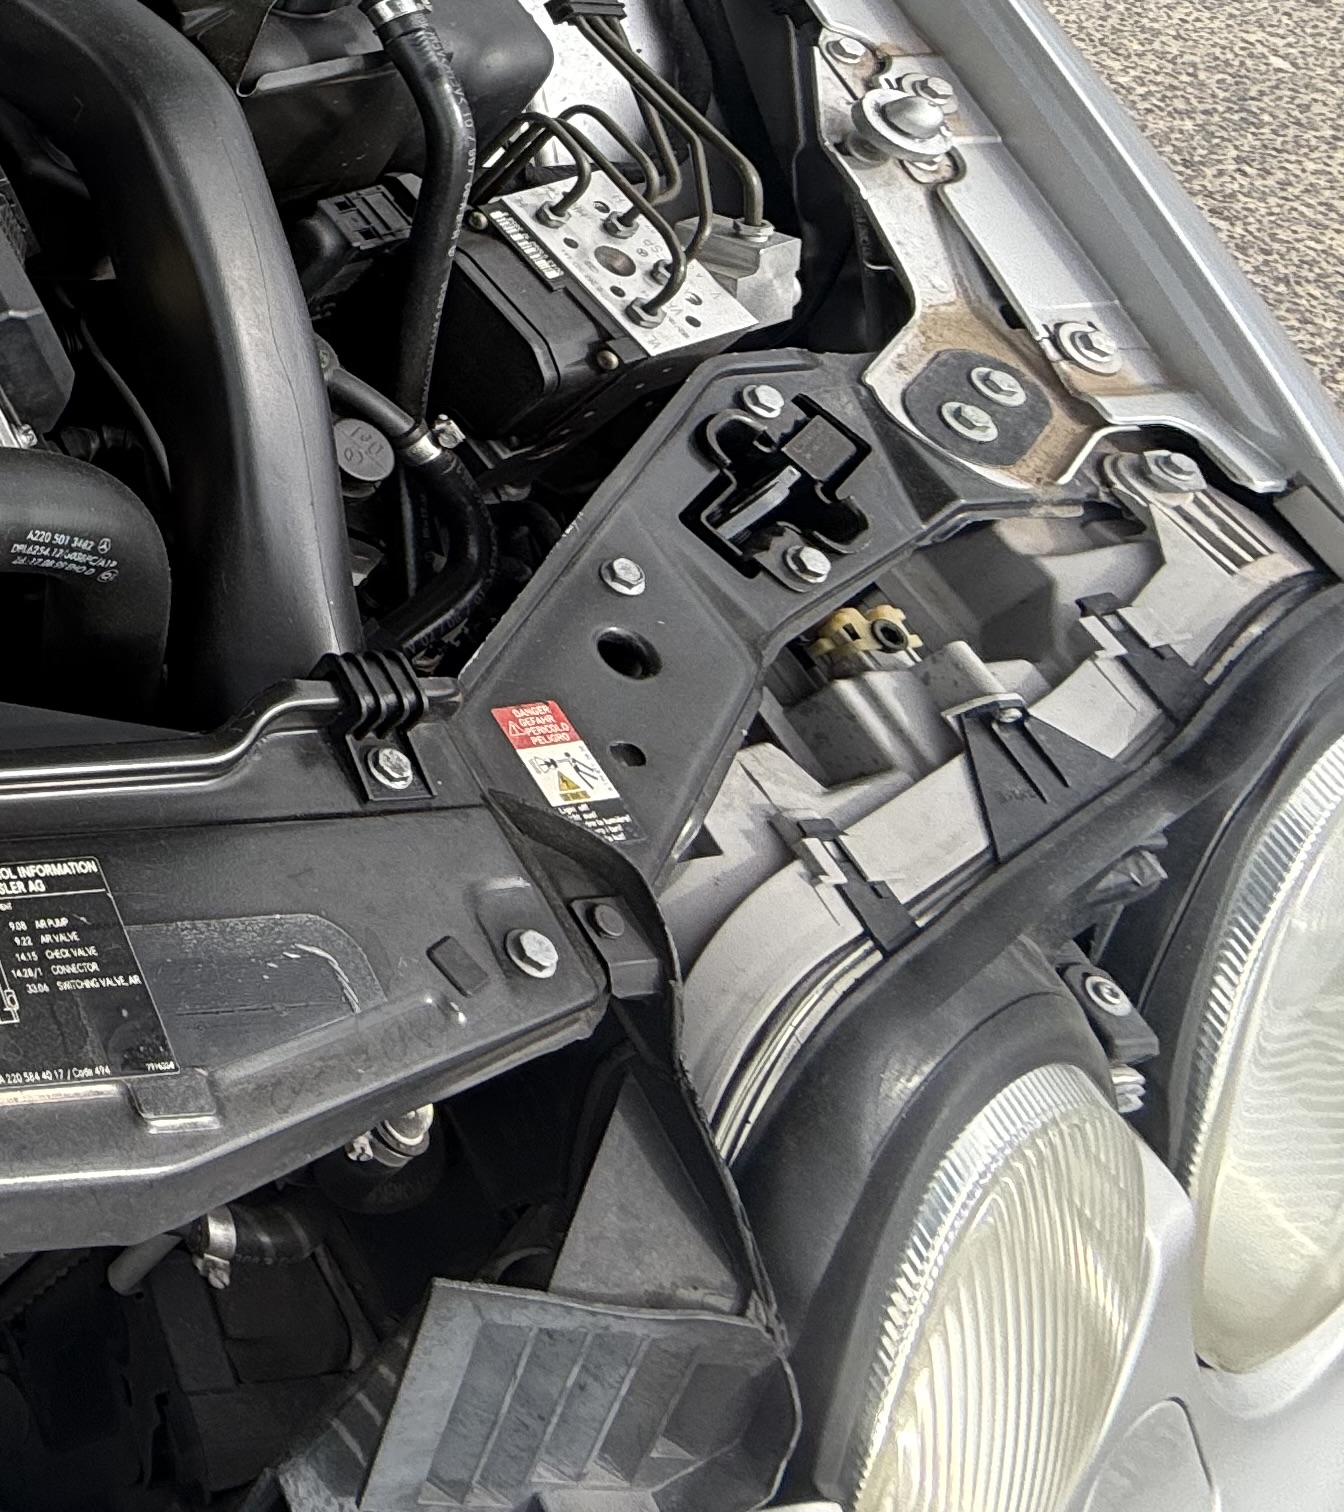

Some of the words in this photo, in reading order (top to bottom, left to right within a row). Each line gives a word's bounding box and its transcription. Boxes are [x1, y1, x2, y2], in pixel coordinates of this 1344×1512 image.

[512, 705, 551, 718] DANGER
[518, 715, 556, 727] GEFAHR
[524, 722, 570, 736] PERICOLO
[530, 733, 571, 746] PELIGRO
[16, 860, 98, 877] INFORMATION
[25, 879, 46, 891] AG
[52, 931, 80, 943] VALVE
[70, 946, 98, 957] VALVE
[51, 962, 100, 976] CONNECTOR
[56, 978, 100, 990] SWITCHING
[5, 1073, 22, 1083] 220
